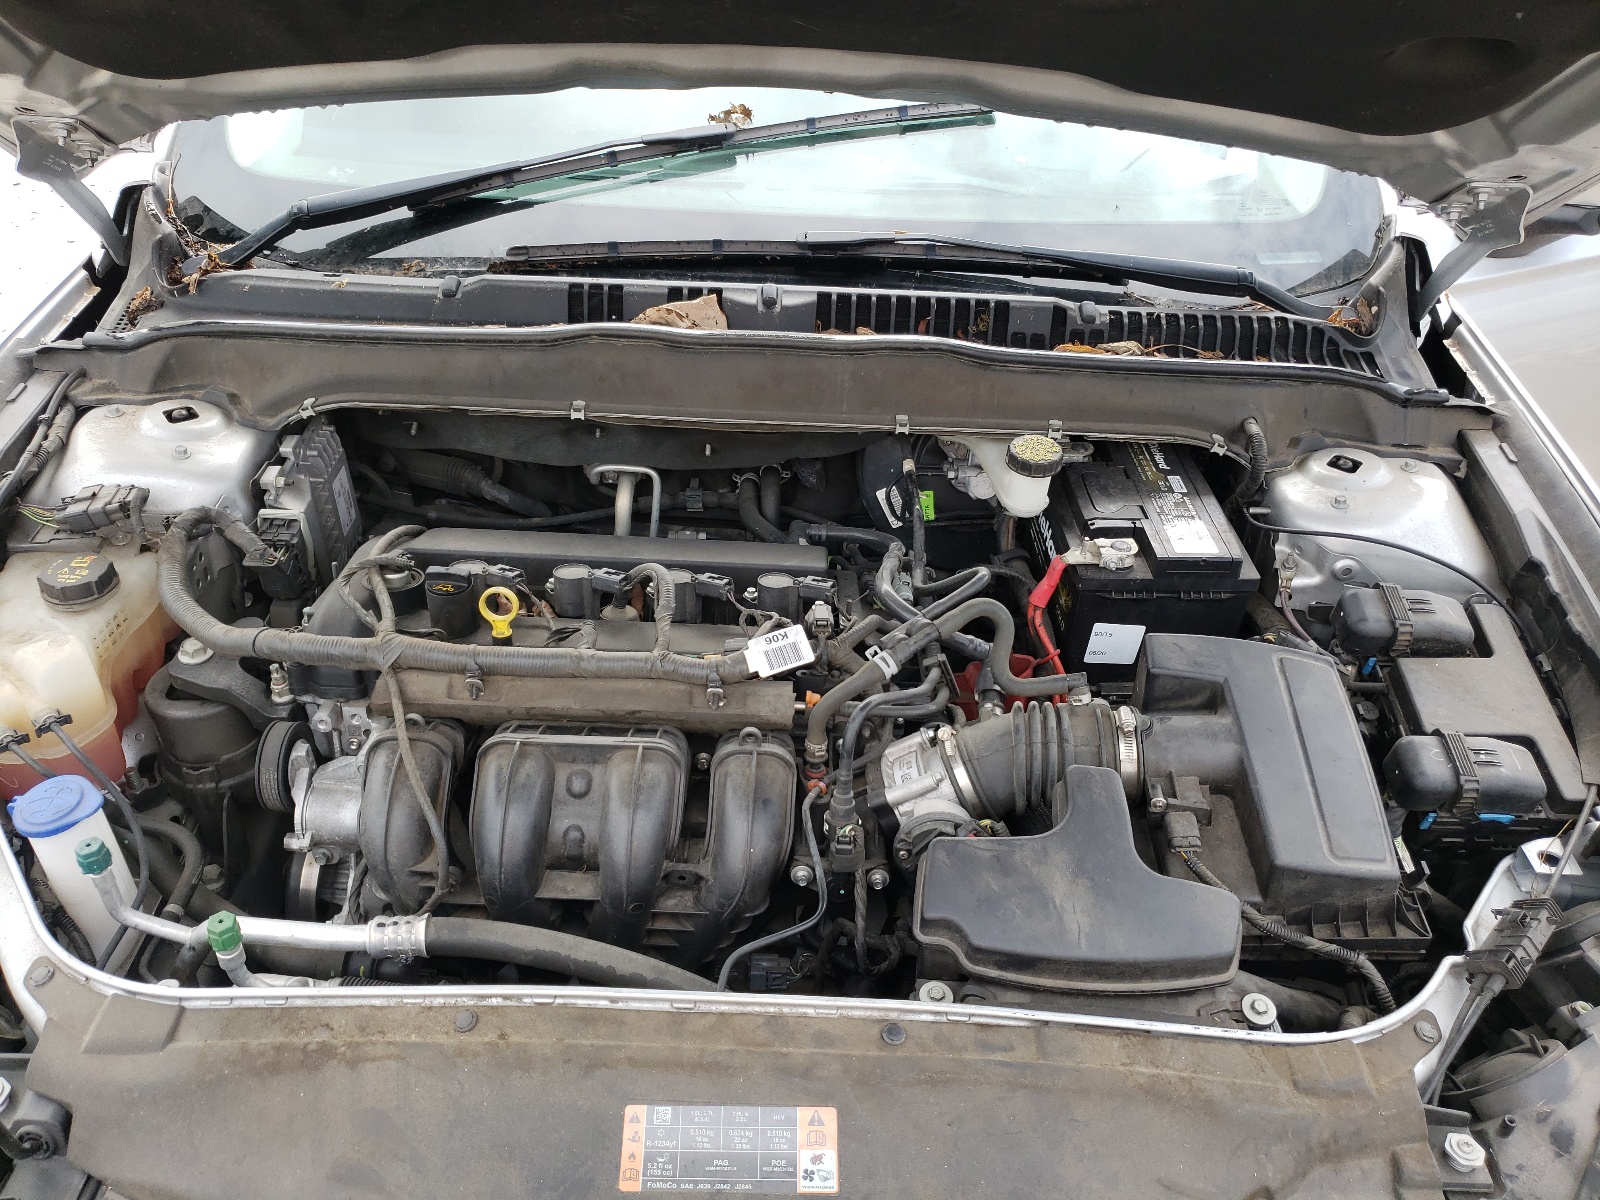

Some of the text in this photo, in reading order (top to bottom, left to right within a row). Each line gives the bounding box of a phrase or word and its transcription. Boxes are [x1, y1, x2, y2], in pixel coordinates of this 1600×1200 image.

[764, 631, 789, 645] K06
[646, 1140, 677, 1148] R-1234yf
[771, 1159, 787, 1167] POE
[647, 1181, 677, 1189] FoMoCo
